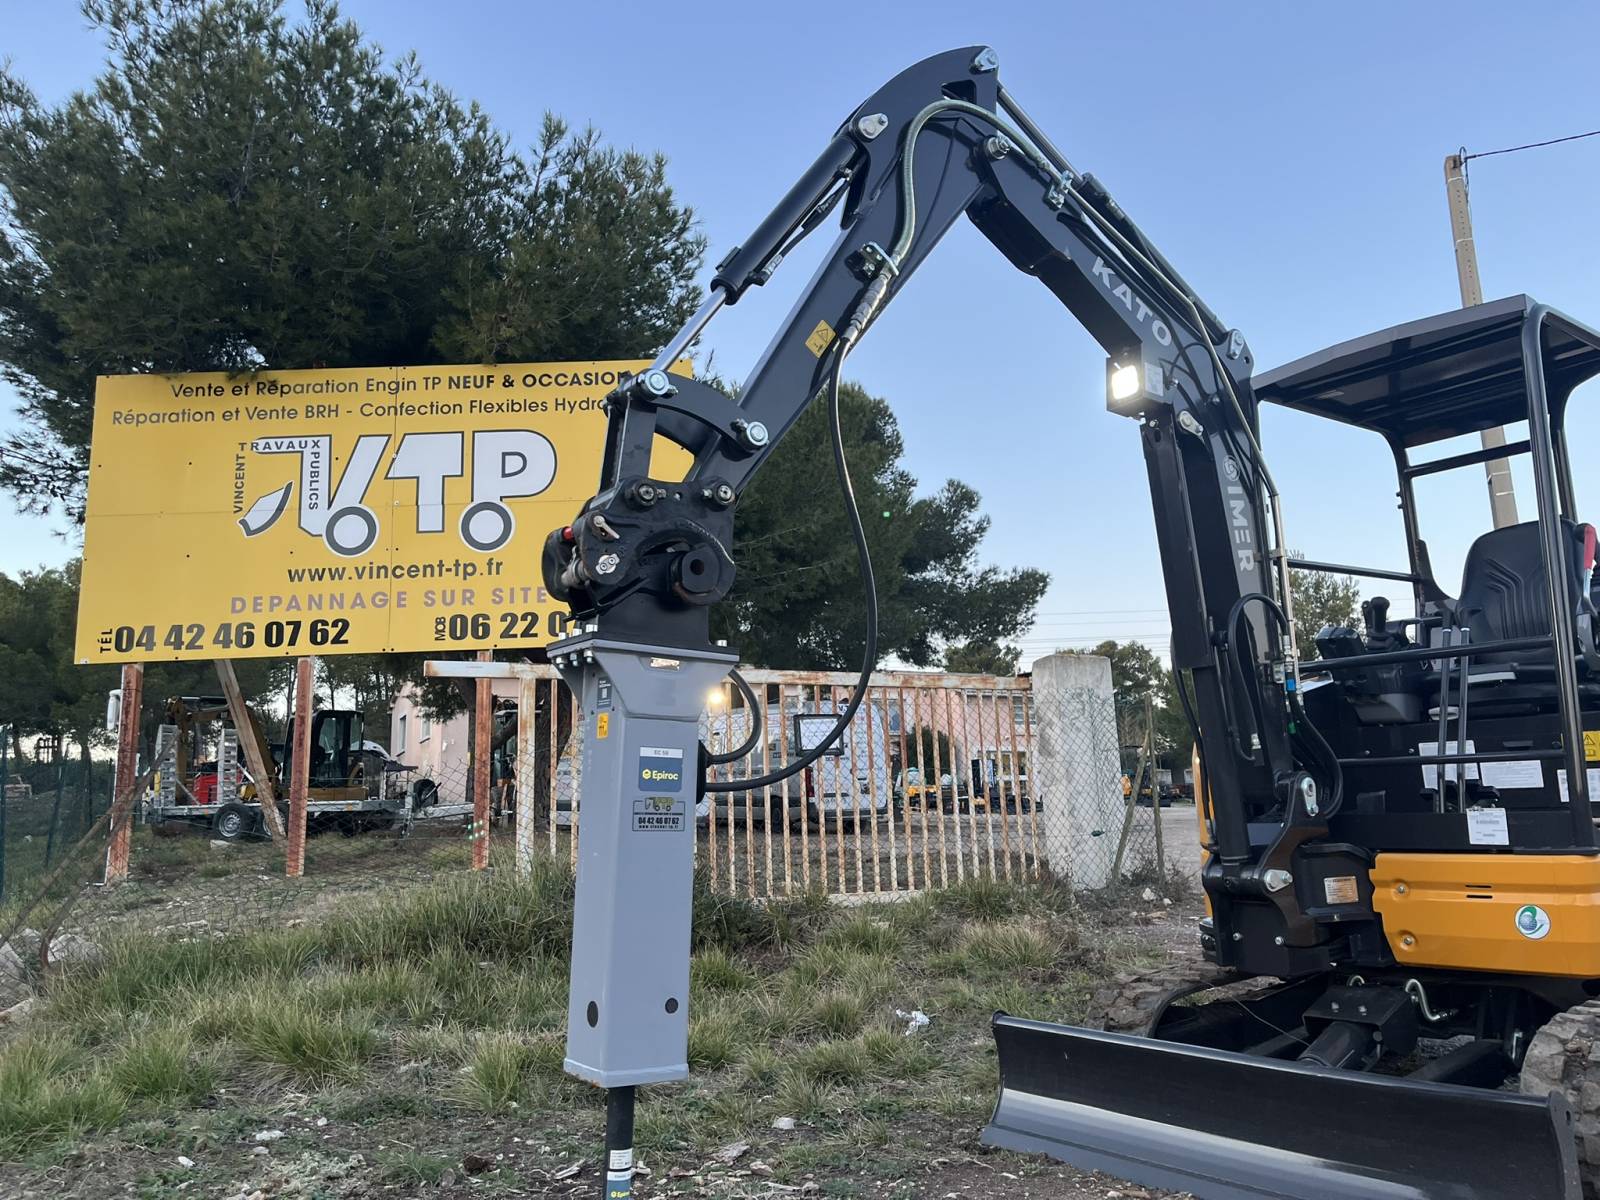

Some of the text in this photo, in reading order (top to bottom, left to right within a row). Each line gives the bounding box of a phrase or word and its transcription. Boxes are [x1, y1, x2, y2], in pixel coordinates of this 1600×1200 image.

[1092, 256, 1172, 346] KATO
[171, 383, 225, 398] Vente
[231, 381, 249, 396] et
[256, 378, 358, 398] Réparation
[366, 377, 417, 395] Engin
[422, 376, 442, 391] TP
[448, 374, 495, 390] NEUF
[502, 374, 514, 388] &
[112, 407, 215, 428] Réparation
[222, 407, 240, 421] et
[245, 405, 298, 421] Vente
[304, 404, 339, 419] BRH
[360, 400, 463, 417] Confection
[469, 397, 548, 414] Flexibles
[238, 439, 321, 451] TRAVAUX
[233, 453, 246, 514] VINCENT
[308, 451, 321, 511] PUBLICS
[1227, 486, 1255, 572] IMER
[287, 558, 504, 583] www.vincent-tp.fr
[230, 586, 547, 615] DEPANNAGE SUR SITE
[98, 627, 113, 654] TÉL
[114, 617, 351, 653] 04 42 46 07 62
[434, 616, 447, 641] MOB
[448, 613, 491, 641] 06
[499, 611, 540, 640] 22
[652, 770, 679, 781] Epiroc
